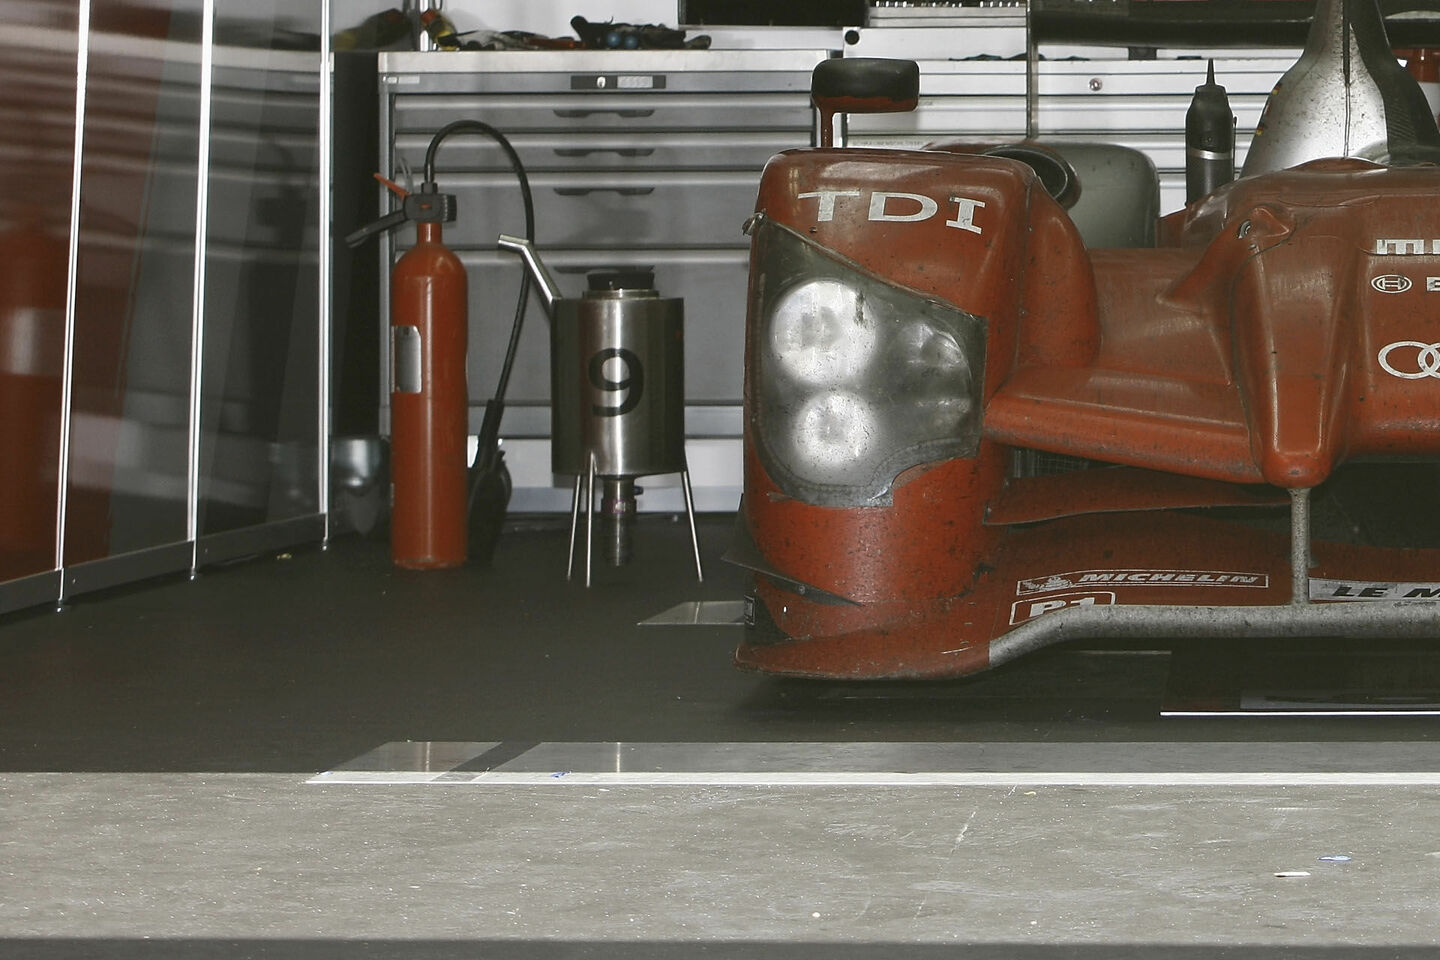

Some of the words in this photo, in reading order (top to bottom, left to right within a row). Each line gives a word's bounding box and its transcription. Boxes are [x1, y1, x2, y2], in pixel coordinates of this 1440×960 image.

[798, 191, 986, 235] TDI
[587, 347, 645, 418] 9
[1077, 572, 1259, 584] MICHELIN
[1332, 586, 1390, 598] LE
